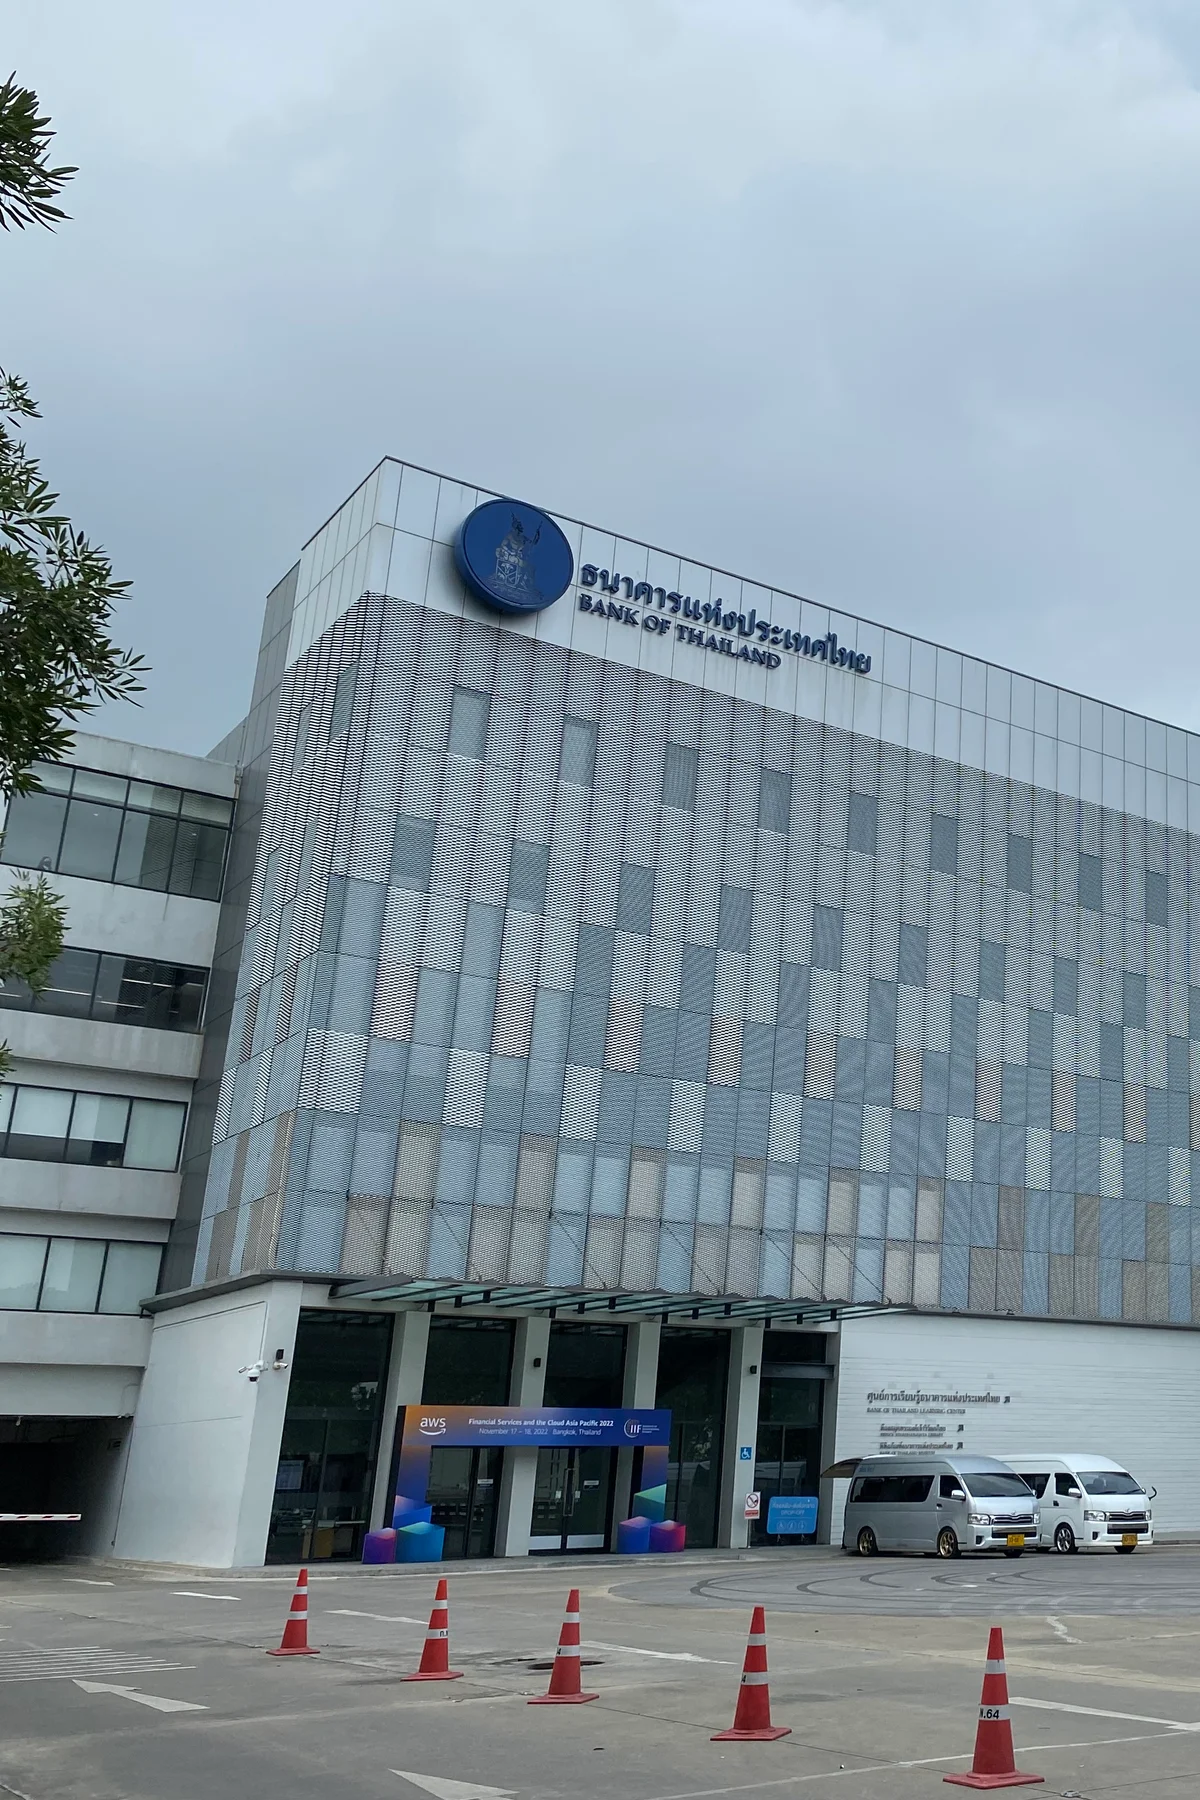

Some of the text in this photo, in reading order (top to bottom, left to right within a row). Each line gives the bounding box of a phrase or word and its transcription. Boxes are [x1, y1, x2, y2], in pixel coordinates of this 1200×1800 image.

[581, 563, 872, 673] ธนาคารแห่งประเทศไทย
[579, 593, 782, 669] BANK OF THAILAND
[420, 1417, 446, 1427] aws
[497, 1418, 522, 1426] Services
[547, 1419, 565, 1427] Cloud
[565, 1419, 579, 1427] Asia
[579, 1419, 599, 1427] Pacific
[552, 1428, 576, 1437] Bangkok,
[630, 1424, 642, 1434] IIF
